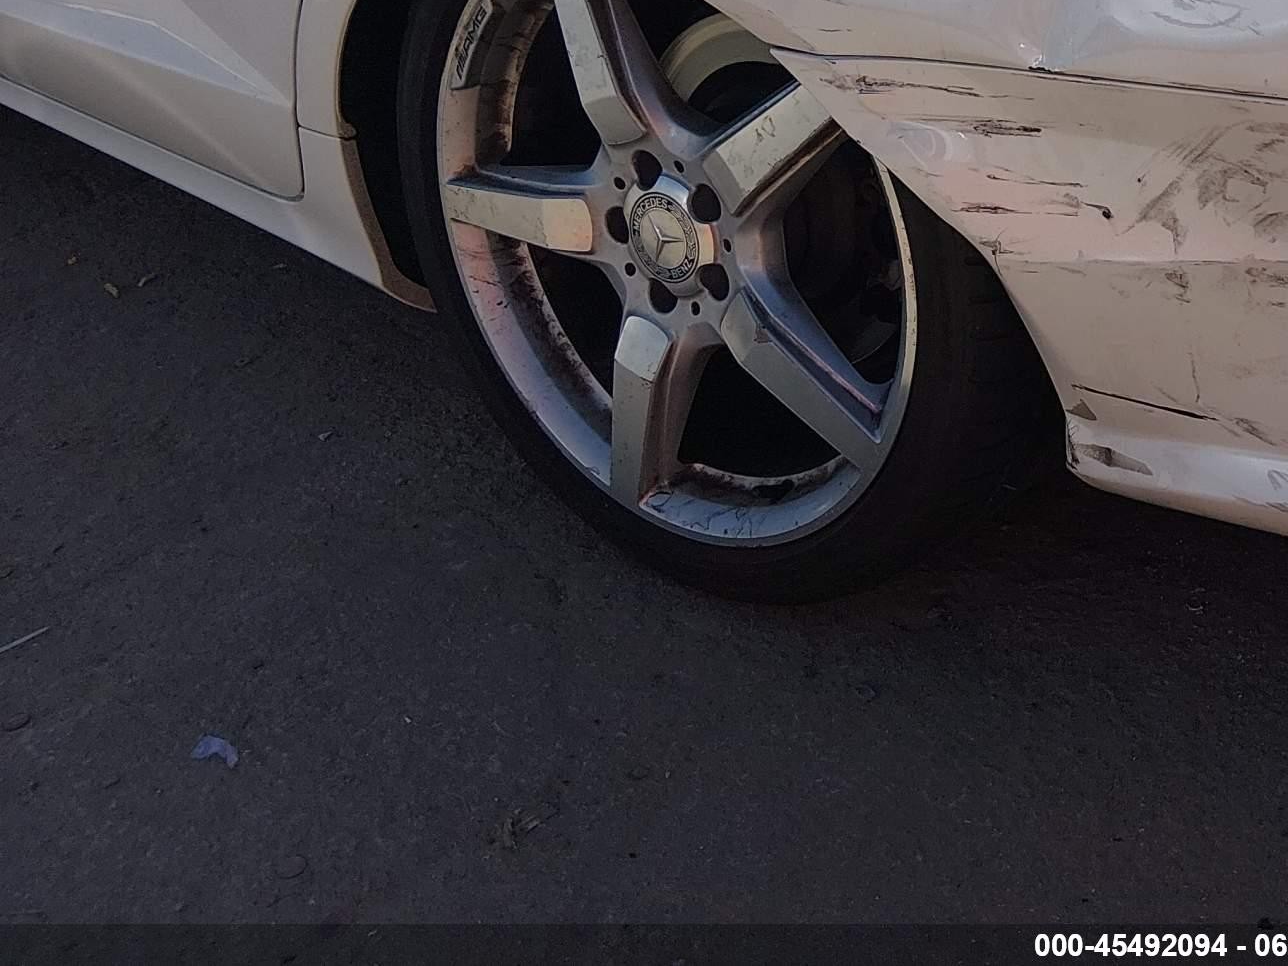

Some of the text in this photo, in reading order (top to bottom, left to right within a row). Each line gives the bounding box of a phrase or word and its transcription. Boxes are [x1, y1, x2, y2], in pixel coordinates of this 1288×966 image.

[461, 5, 488, 62] AMG
[632, 197, 669, 232] MERCEDES
[670, 258, 694, 279] BENZ
